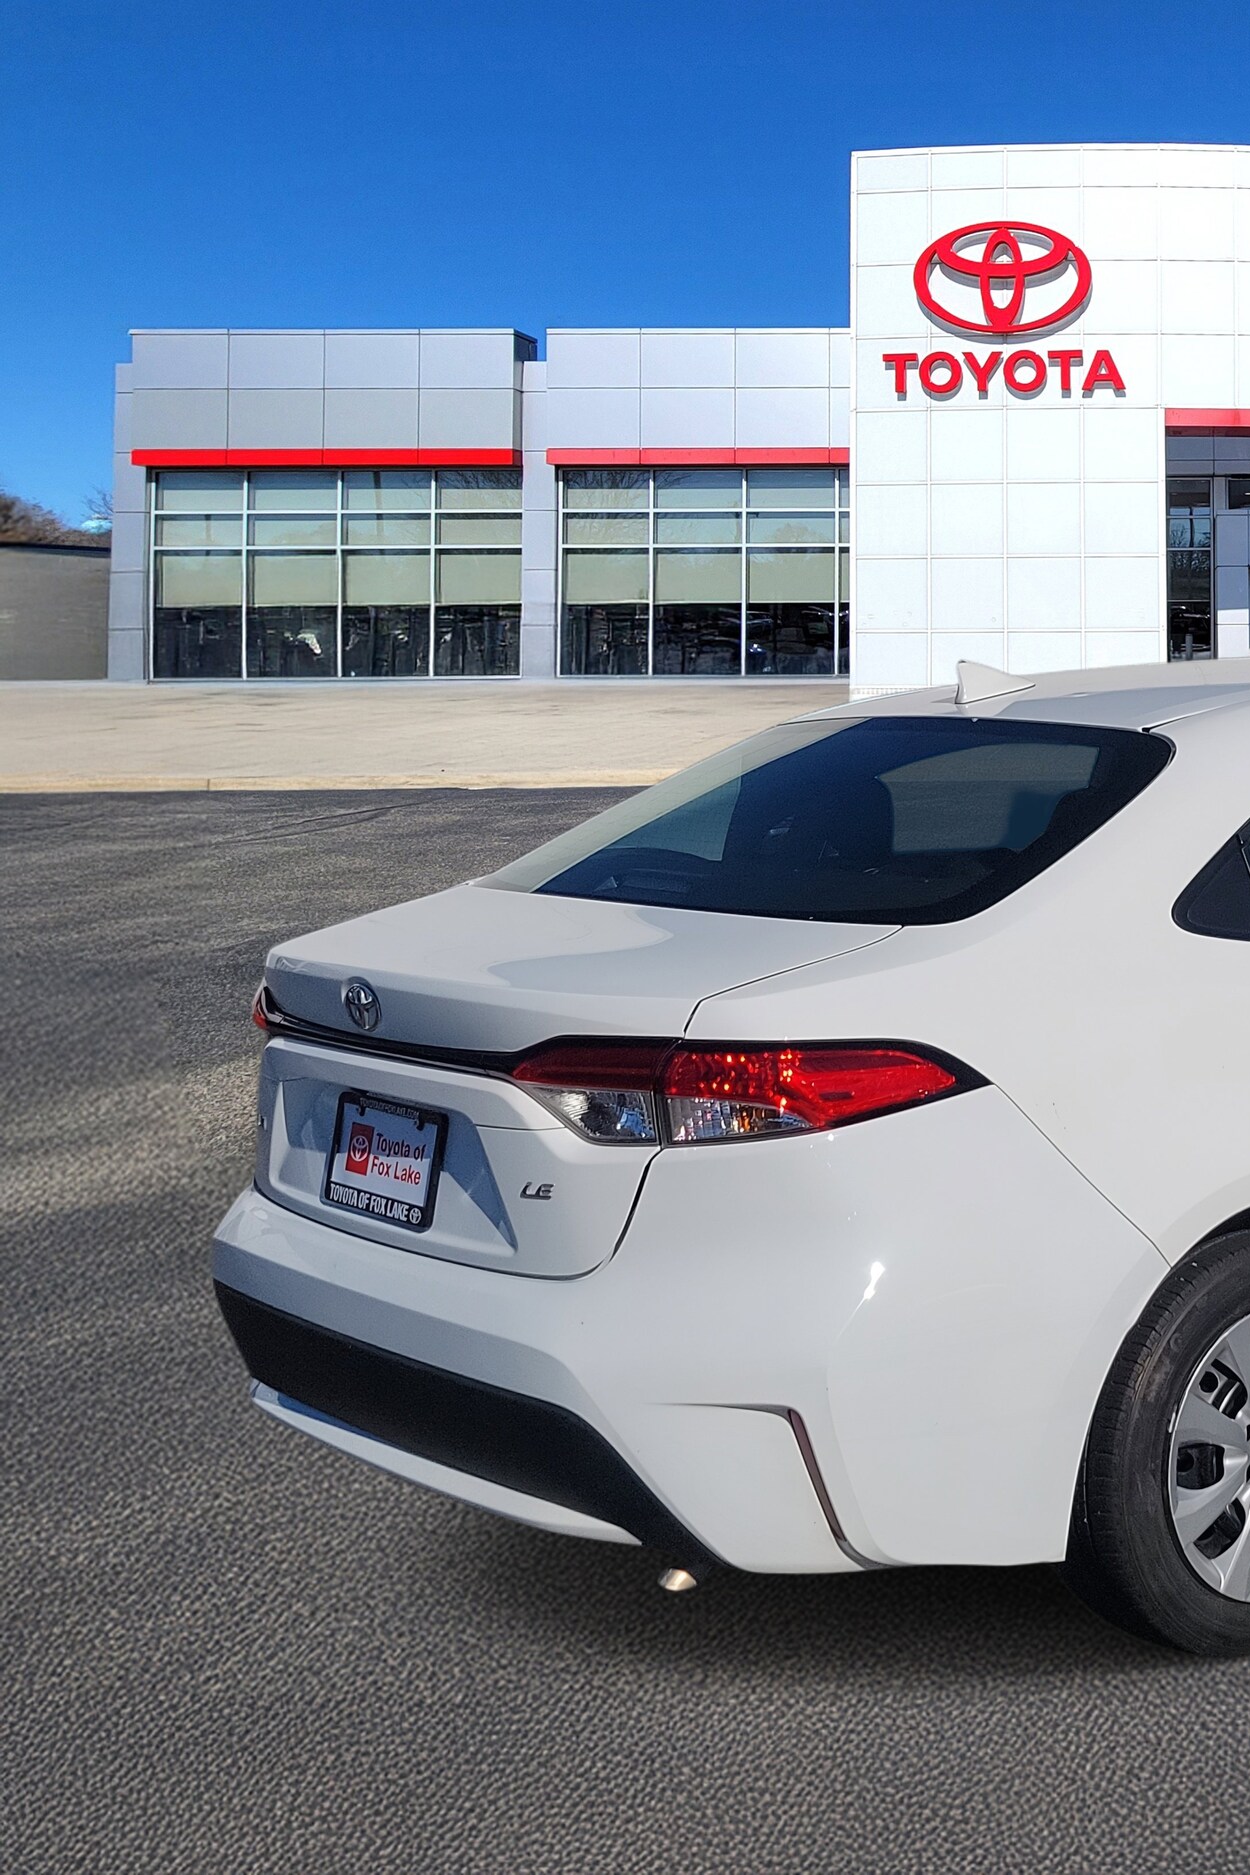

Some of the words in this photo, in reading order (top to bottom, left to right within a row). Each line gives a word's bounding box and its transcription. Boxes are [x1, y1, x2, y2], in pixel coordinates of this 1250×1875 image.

[882, 350, 1126, 397] TOYOTA
[376, 1133, 410, 1157] Toyota
[413, 1143, 427, 1162] of
[370, 1156, 392, 1177] Fox
[393, 1161, 421, 1185] Lake
[329, 1183, 357, 1207] TOYOTA
[357, 1191, 370, 1211] OF
[369, 1195, 387, 1216] FOX
[386, 1202, 410, 1222] LAKE
[520, 1181, 554, 1200] LE
